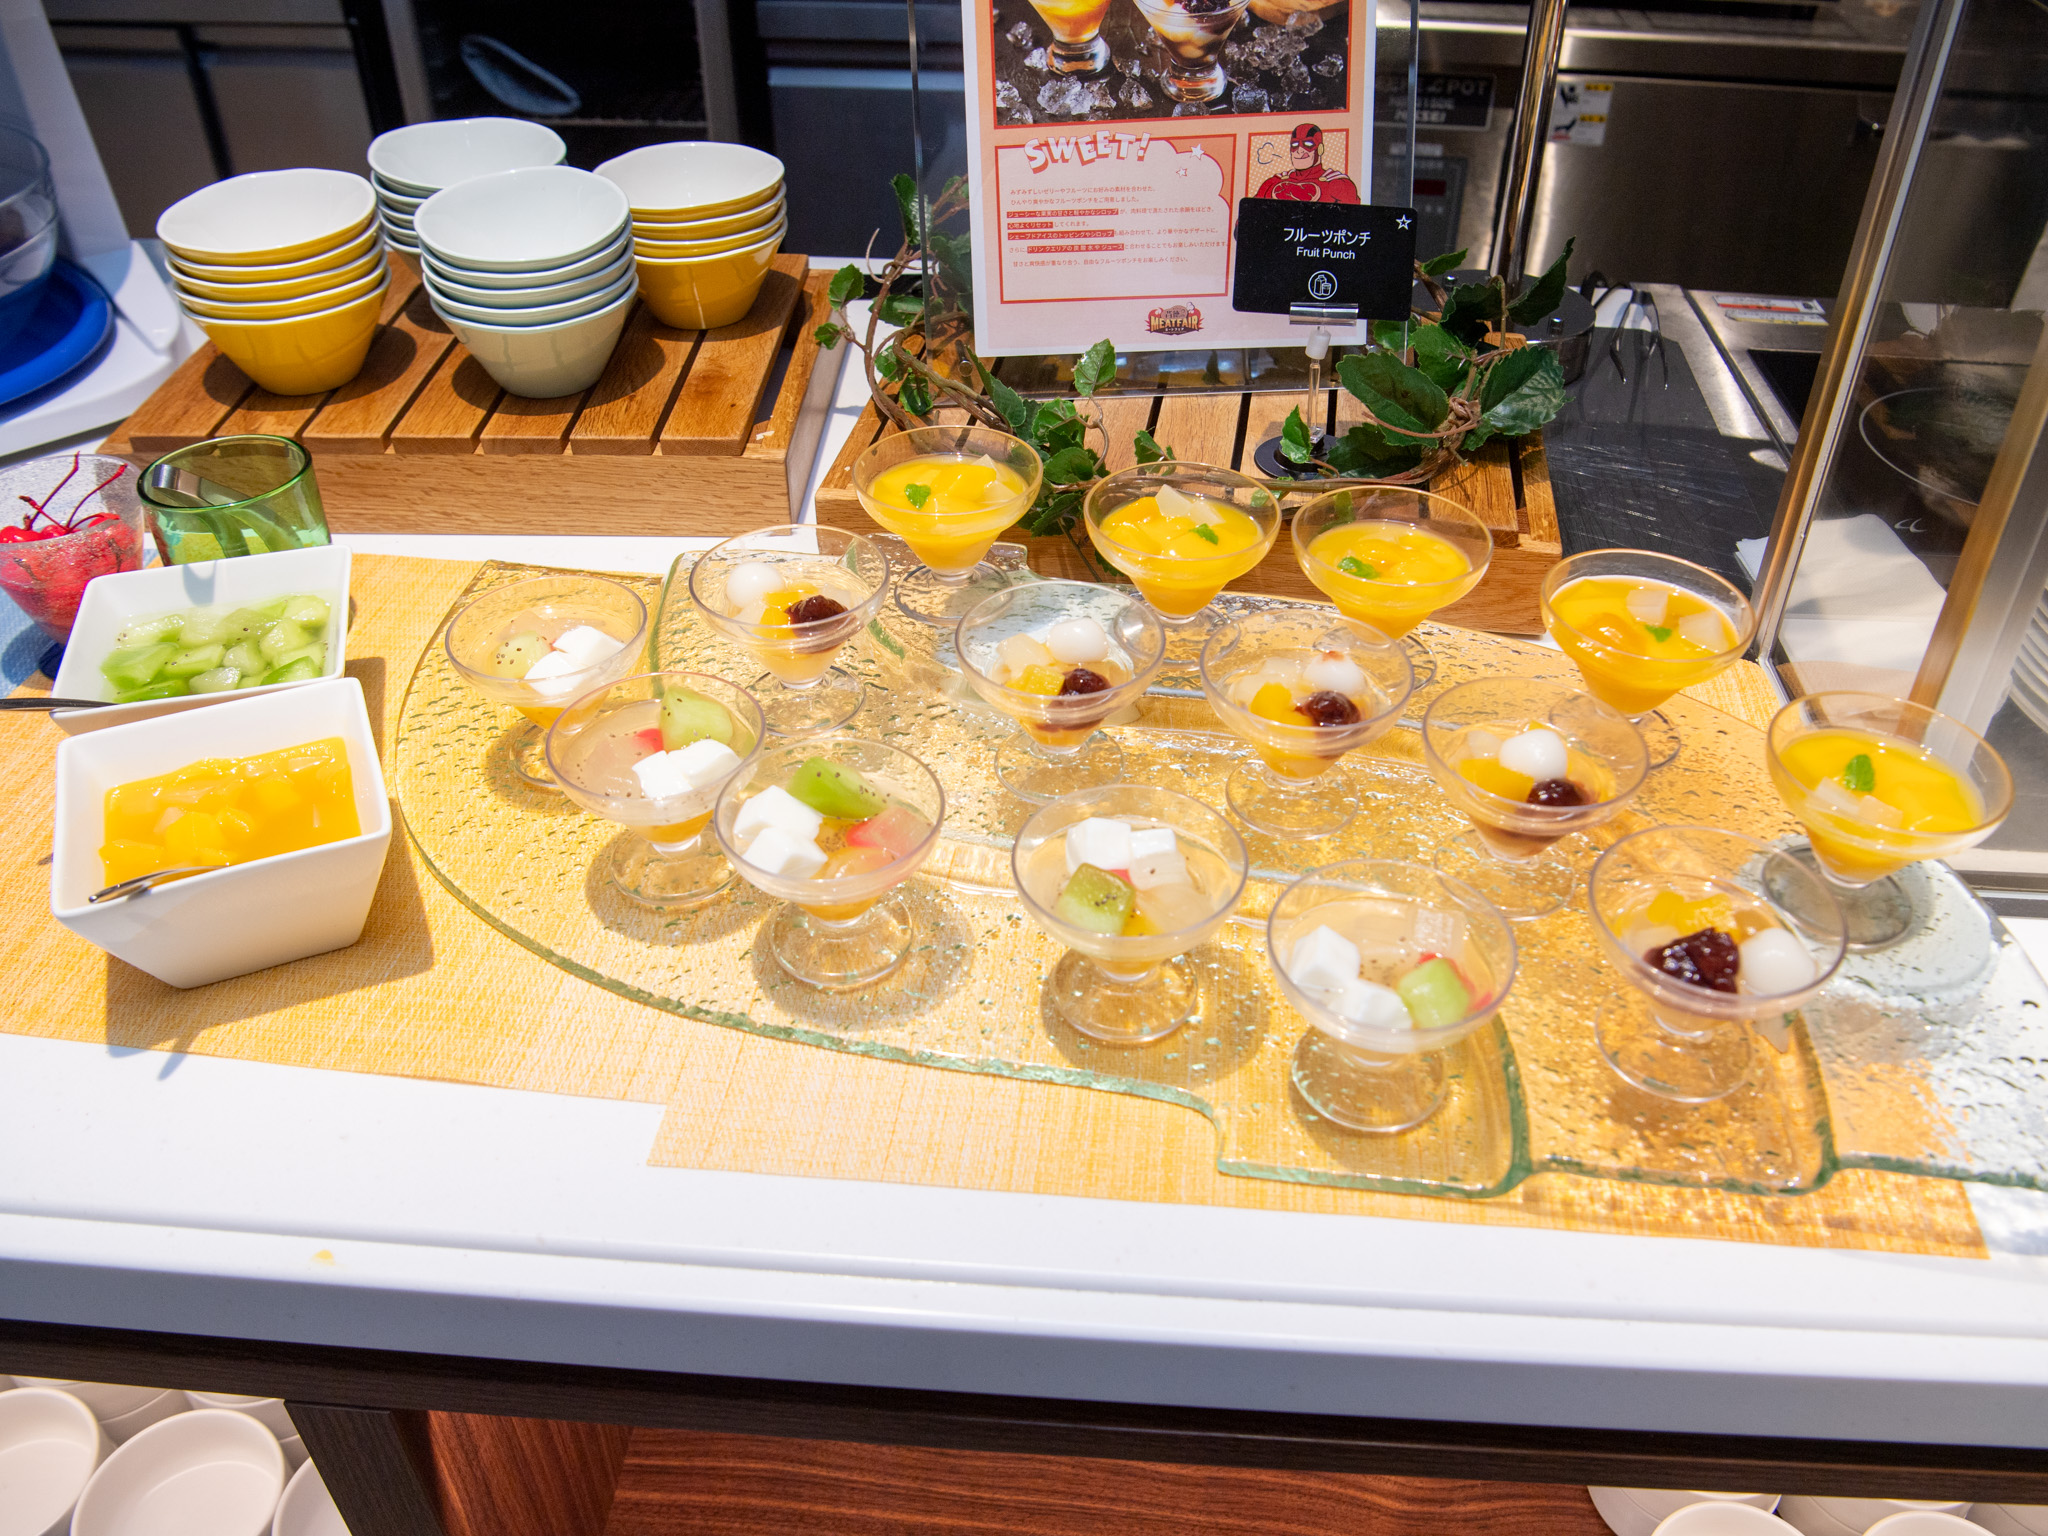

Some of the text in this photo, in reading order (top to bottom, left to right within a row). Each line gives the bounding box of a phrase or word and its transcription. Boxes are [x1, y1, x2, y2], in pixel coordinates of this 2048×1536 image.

[1024, 130, 1151, 174] SWEET!
[1283, 227, 1371, 247] フルーツポンチ
[1296, 246, 1356, 260] Fruit Punch
[1150, 315, 1199, 331] MEATFAIR
